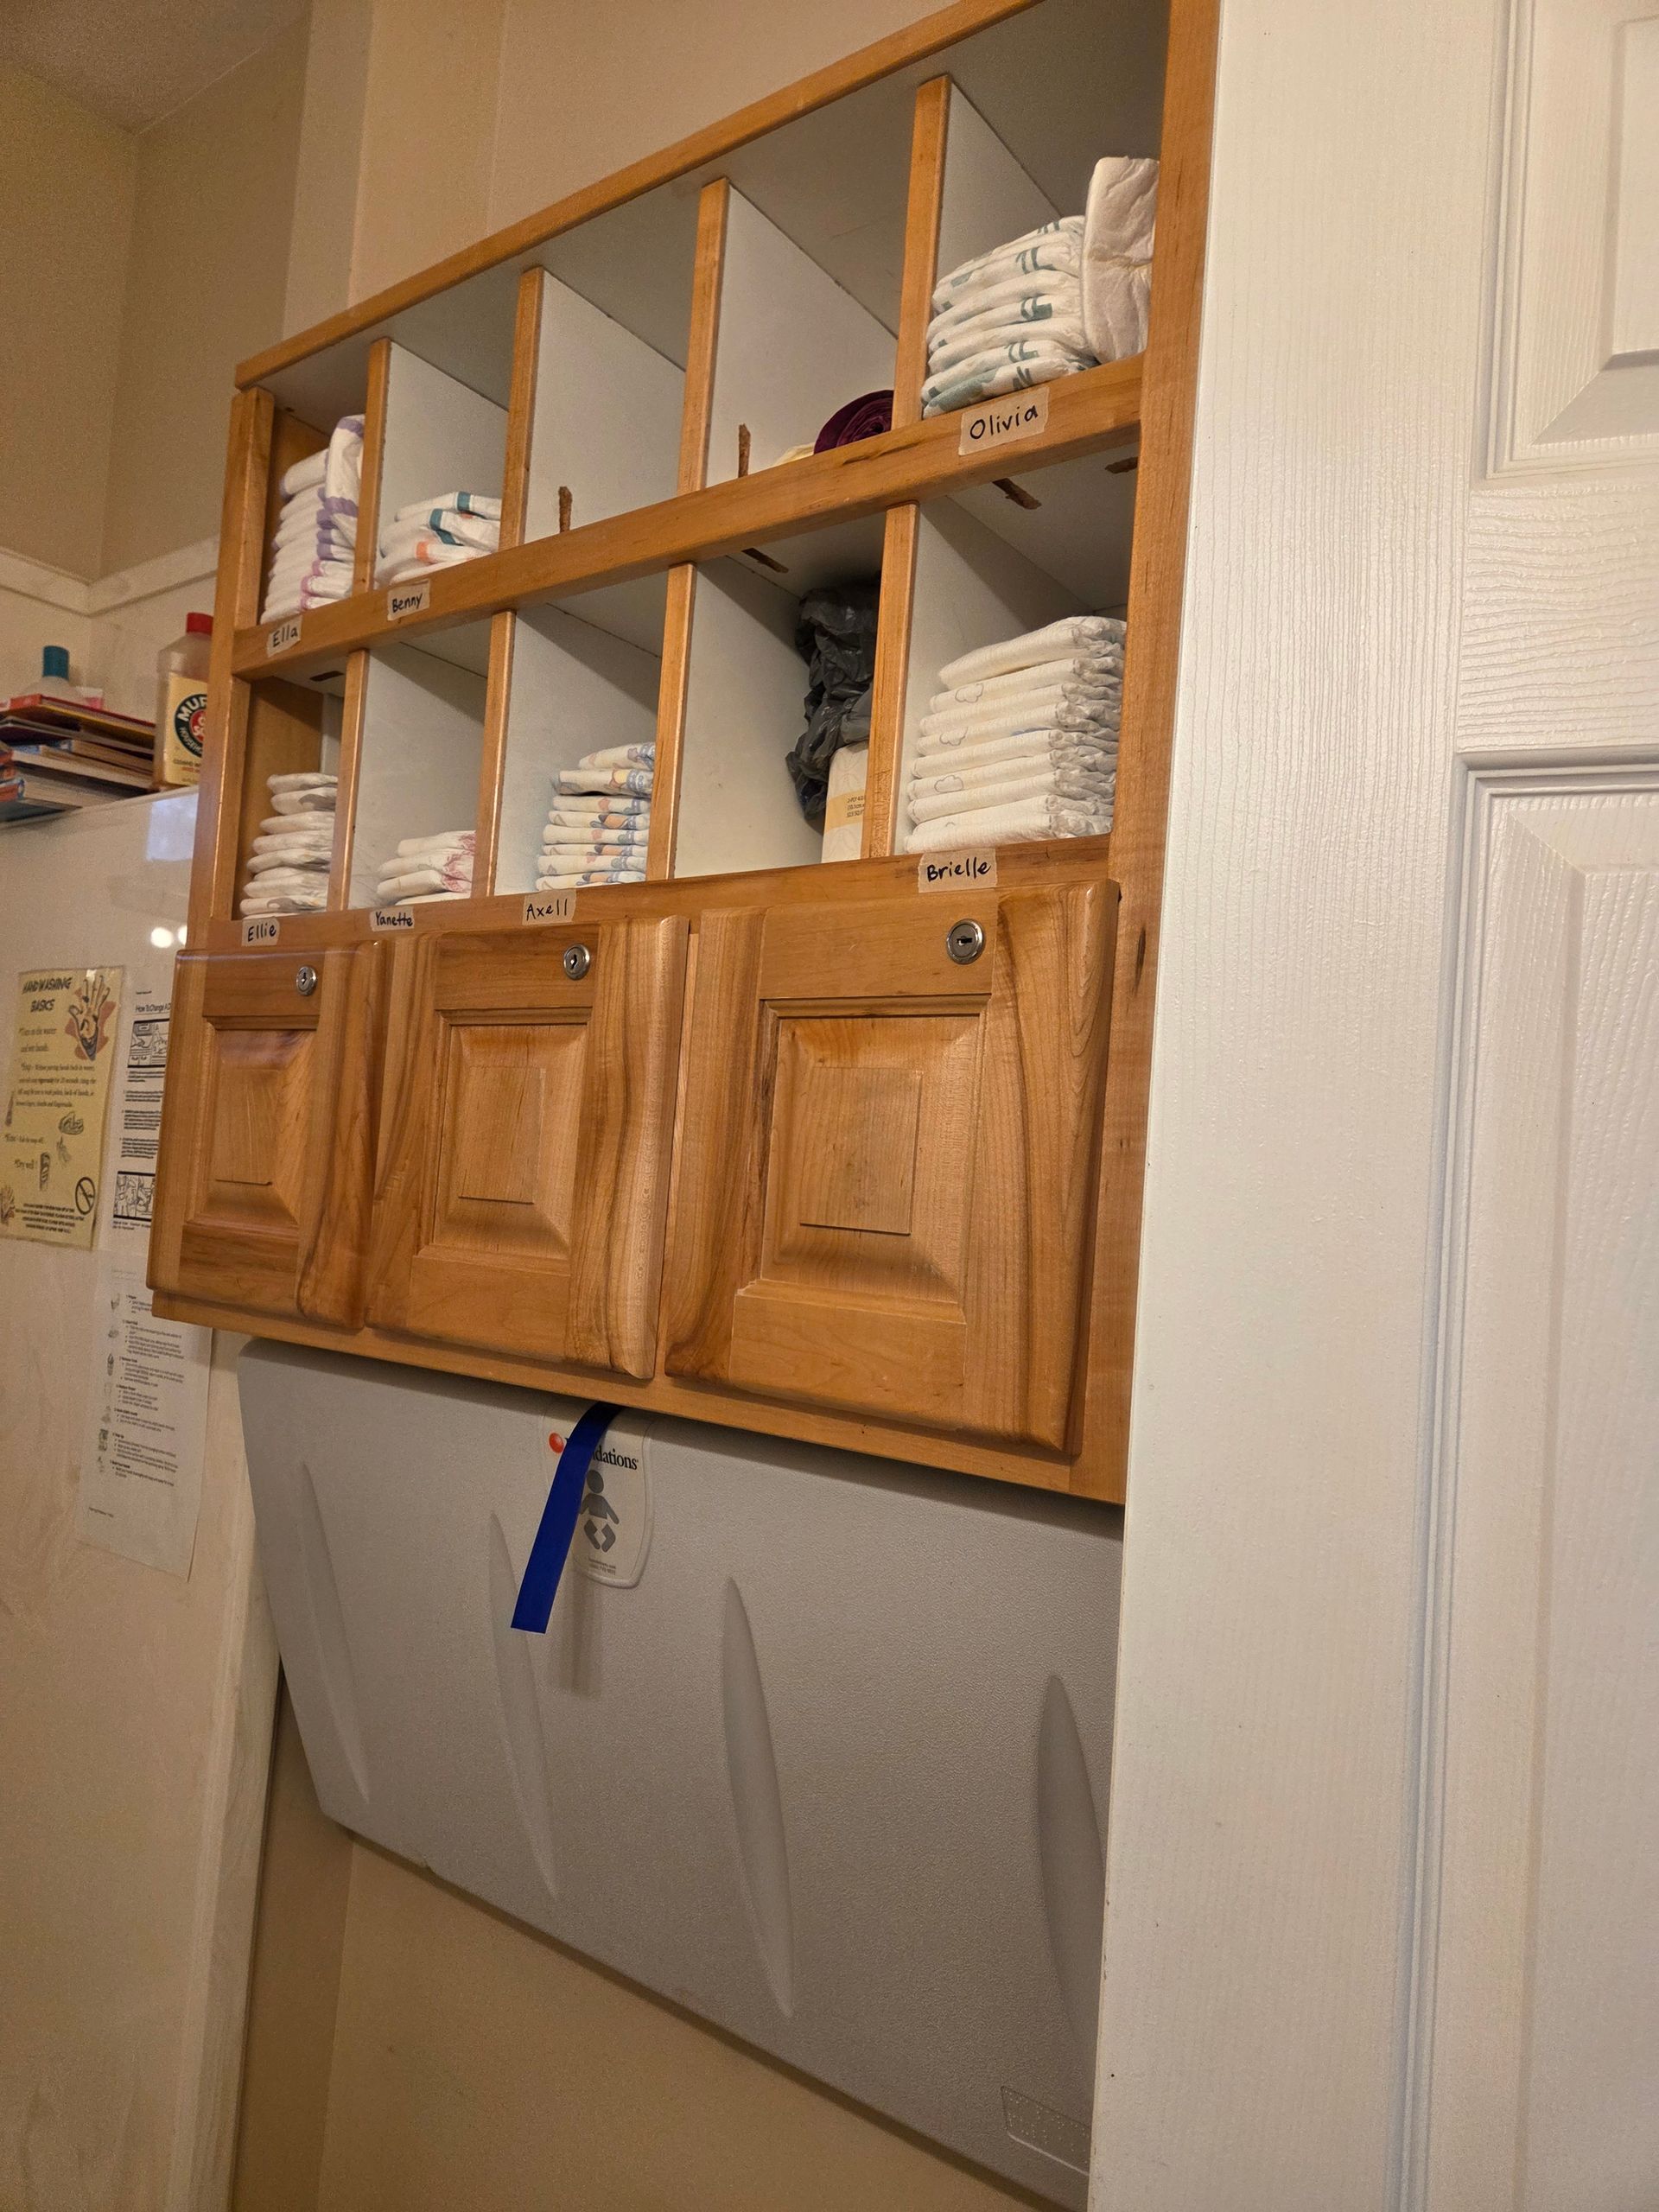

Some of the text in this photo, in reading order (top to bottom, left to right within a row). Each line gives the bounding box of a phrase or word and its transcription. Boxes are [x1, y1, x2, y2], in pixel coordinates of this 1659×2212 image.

[969, 404, 1039, 440] Olivia
[391, 593, 423, 613] Benny
[272, 624, 298, 648] Ella
[926, 856, 992, 883] Brielle
[375, 911, 414, 927] Yanette
[526, 898, 568, 921] Axell
[247, 922, 276, 942] Ellie
